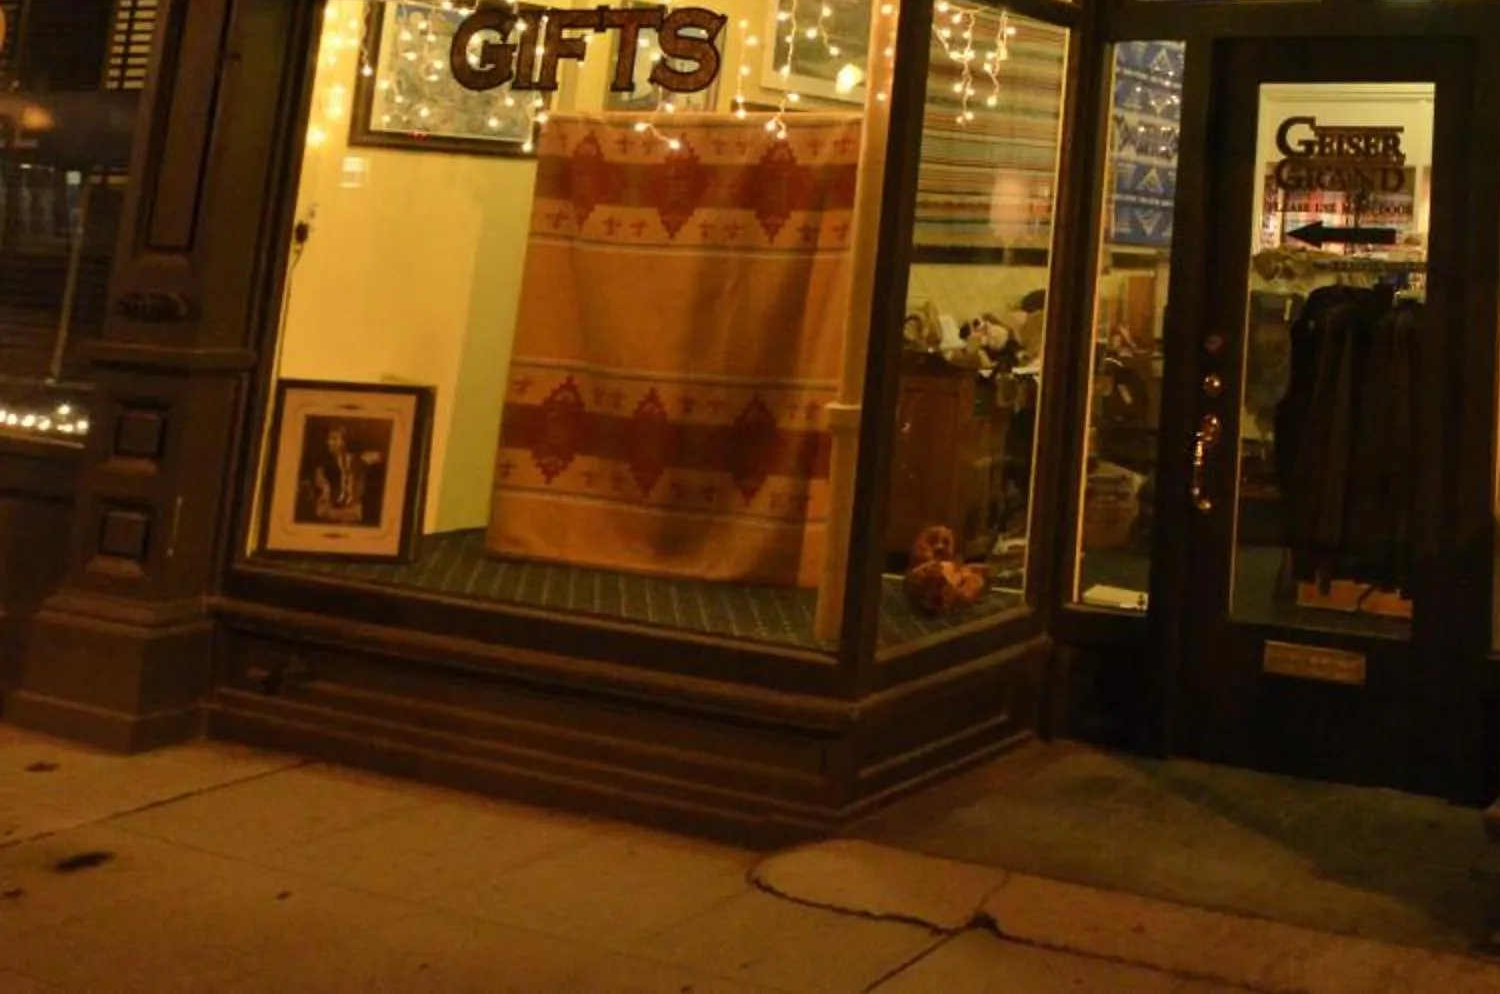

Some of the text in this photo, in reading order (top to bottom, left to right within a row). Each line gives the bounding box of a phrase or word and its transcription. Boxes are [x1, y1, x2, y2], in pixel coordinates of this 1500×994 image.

[450, 5, 728, 93] GIFTS
[1276, 116, 1406, 164] GEISER
[1275, 156, 1406, 192] GRAND
